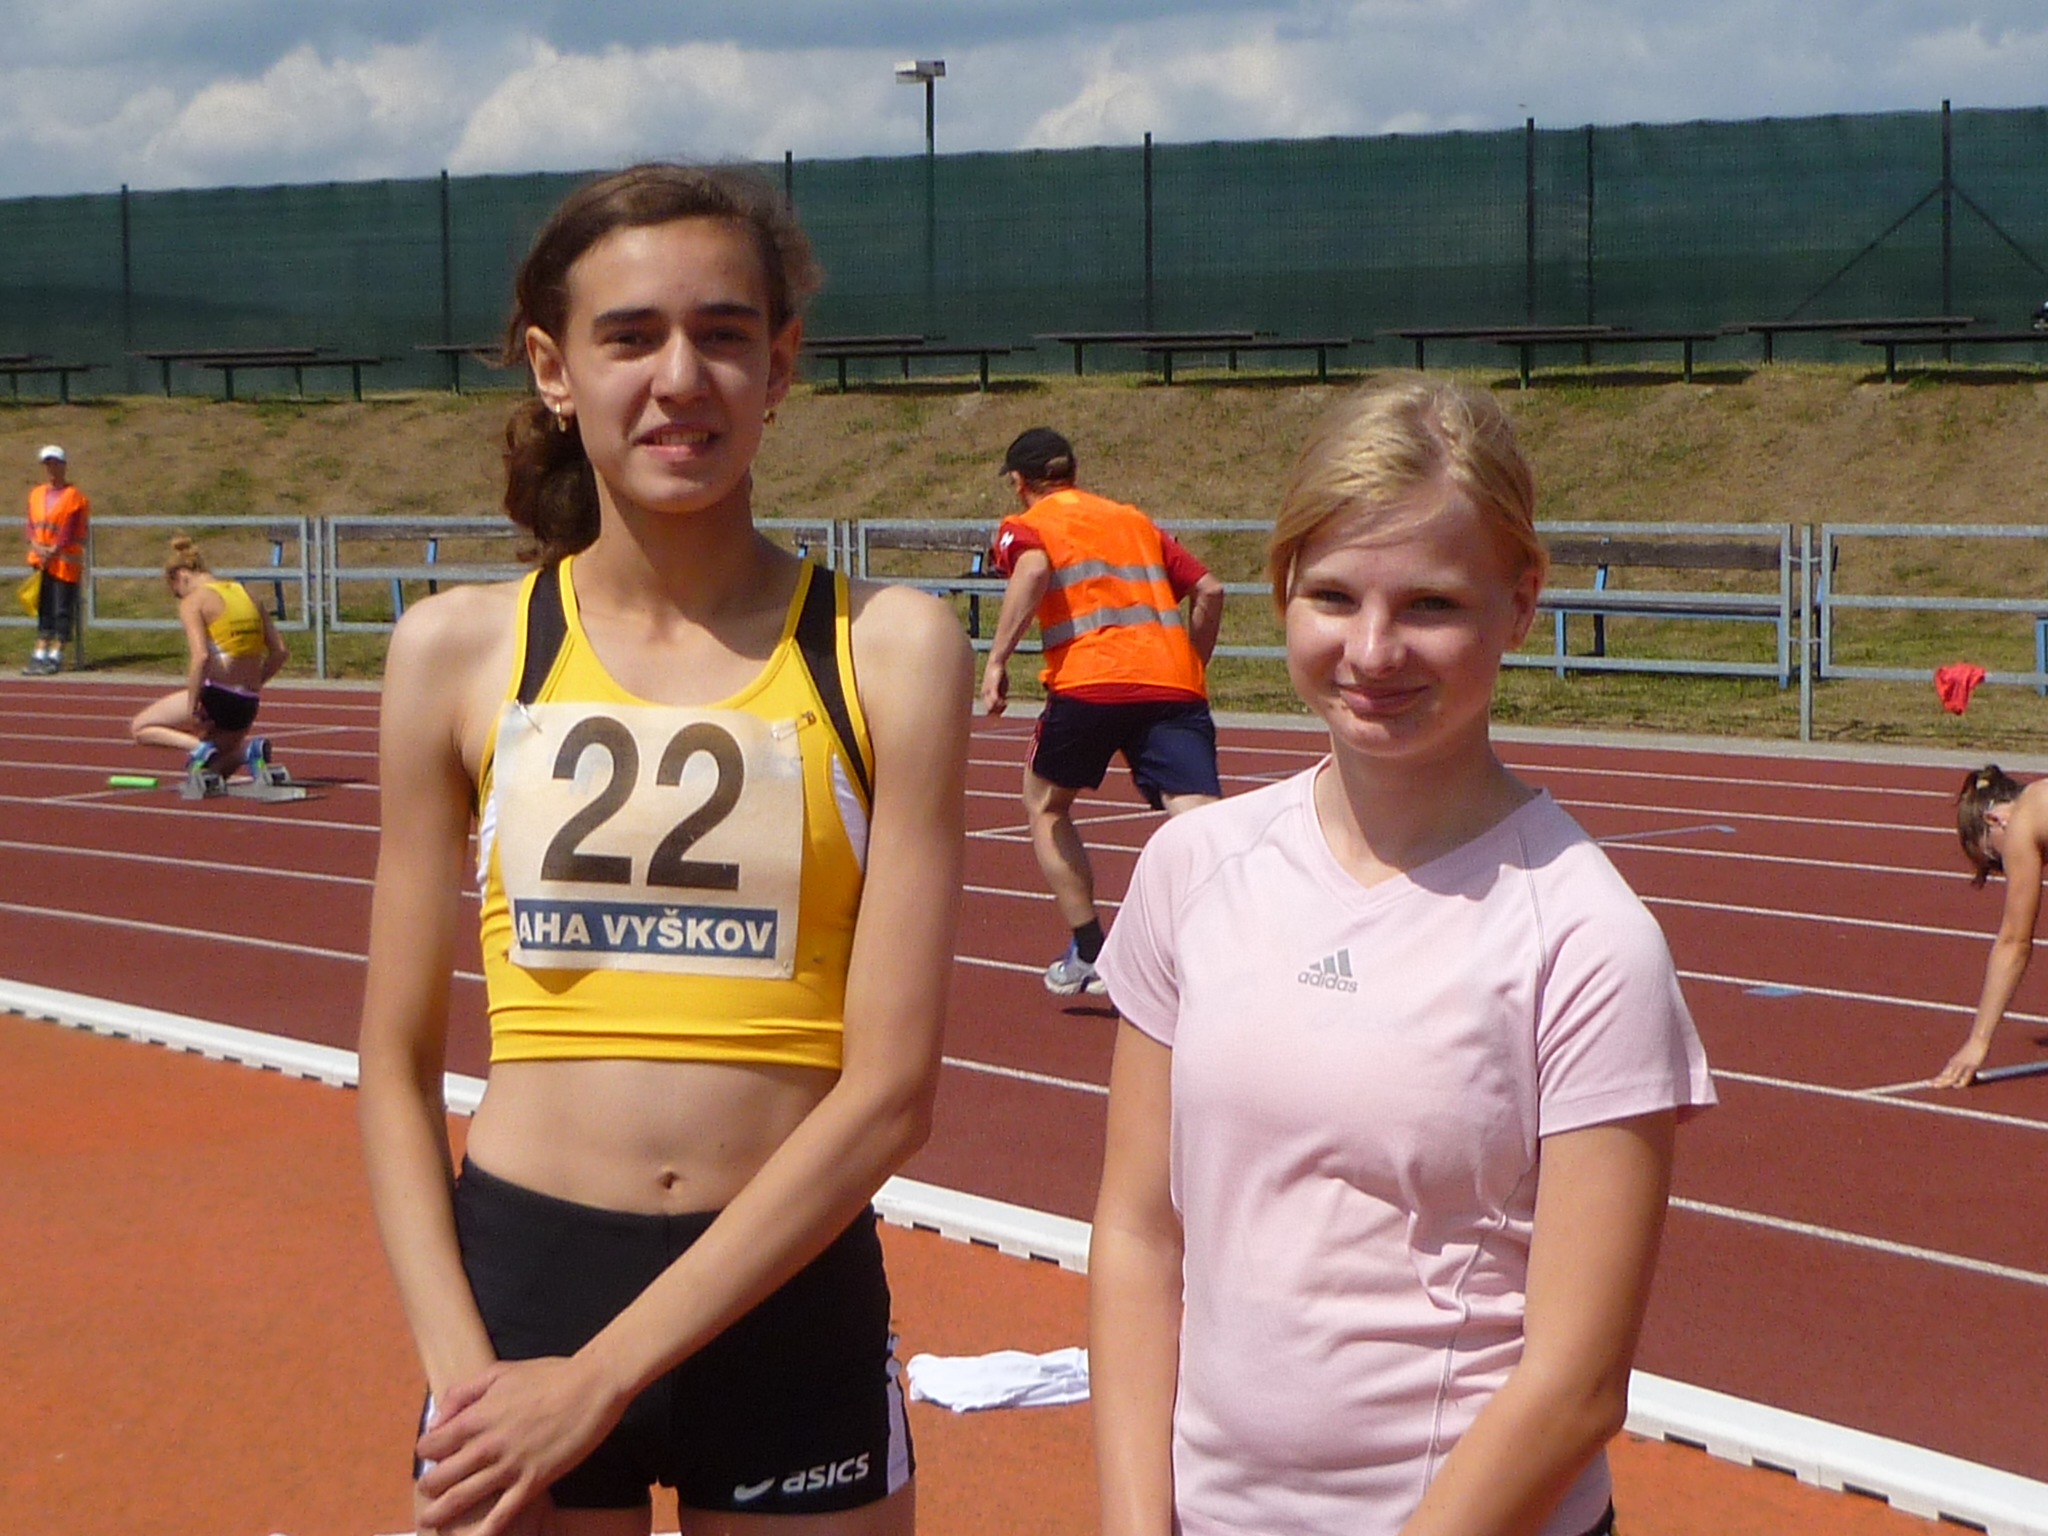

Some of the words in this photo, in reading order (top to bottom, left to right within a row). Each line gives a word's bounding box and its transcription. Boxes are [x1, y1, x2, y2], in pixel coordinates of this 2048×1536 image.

[541, 715, 745, 891] 22
[602, 908, 773, 952] VYŠKOV
[1297, 970, 1358, 993] adidas
[781, 1452, 870, 1493] asics
